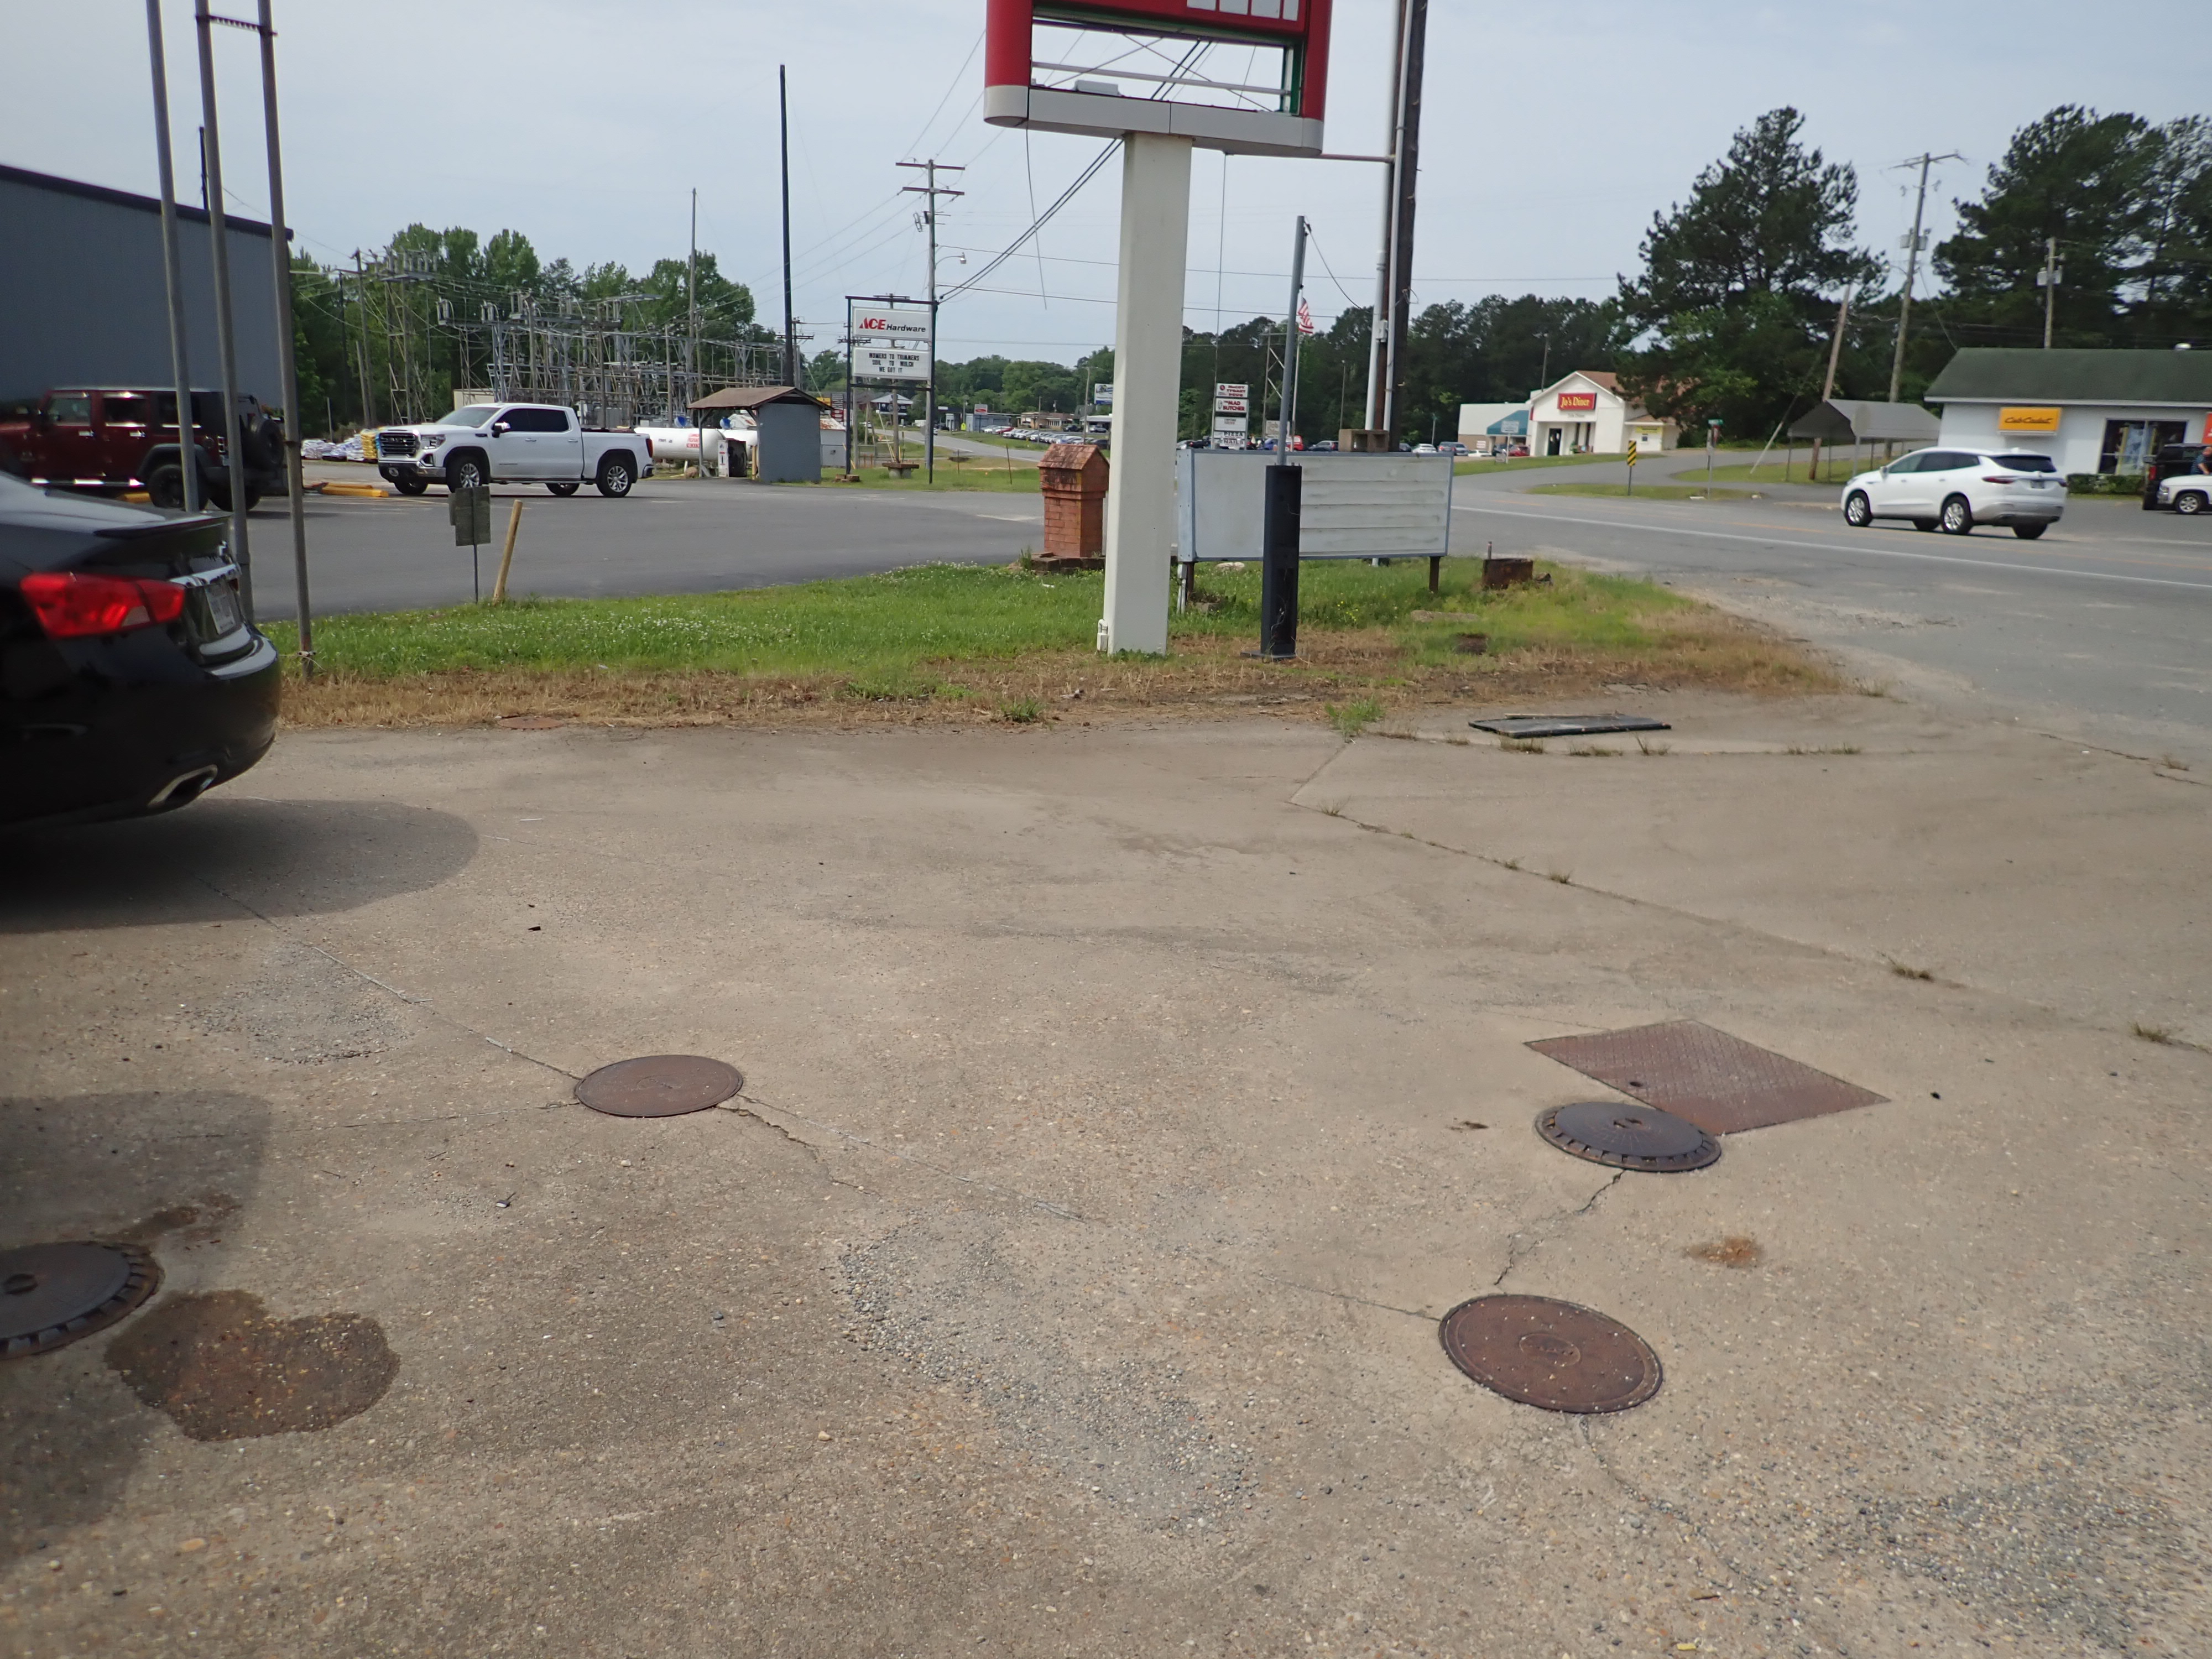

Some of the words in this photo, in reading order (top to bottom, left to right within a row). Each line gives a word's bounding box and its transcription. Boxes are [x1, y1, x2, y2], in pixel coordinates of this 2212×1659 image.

[858, 317, 886, 330] ACE
[886, 324, 926, 332] Hardware
[1560, 397, 1572, 408] Jo's
[1573, 397, 1590, 406] Diner
